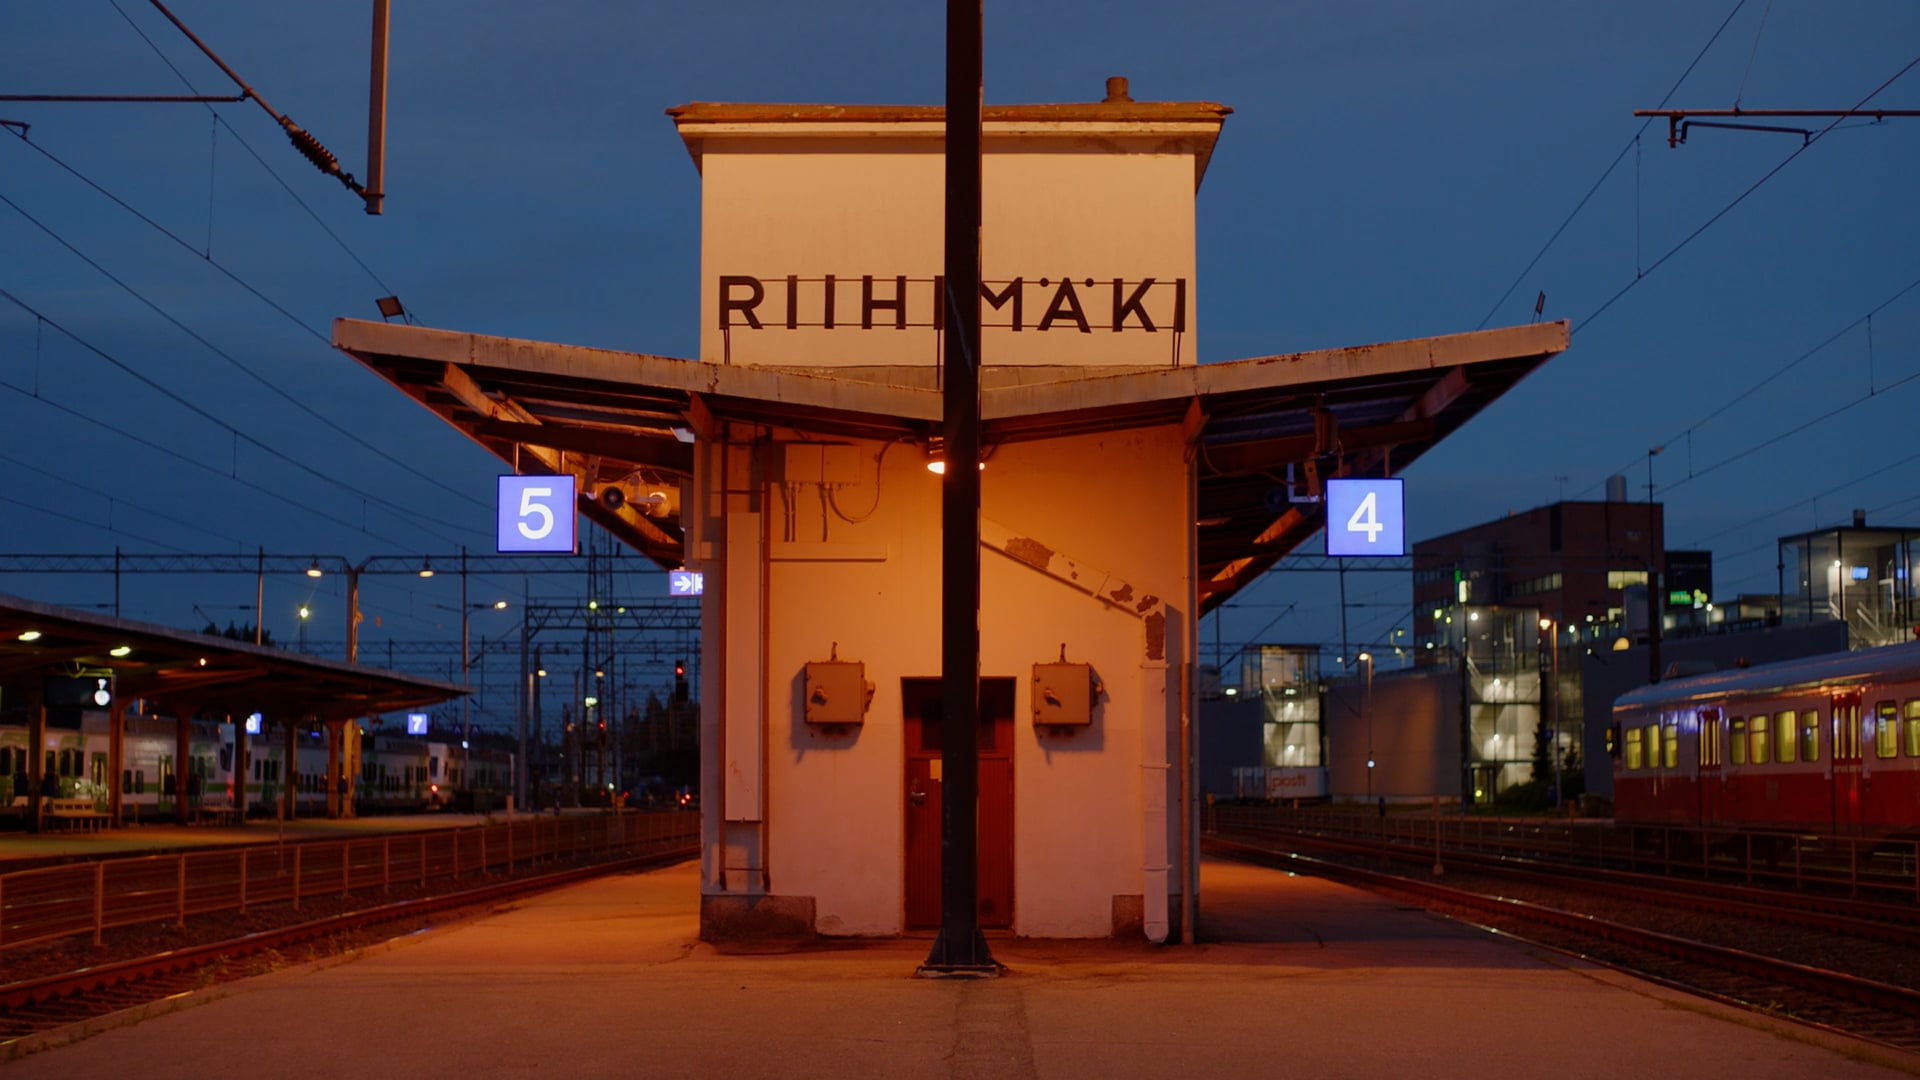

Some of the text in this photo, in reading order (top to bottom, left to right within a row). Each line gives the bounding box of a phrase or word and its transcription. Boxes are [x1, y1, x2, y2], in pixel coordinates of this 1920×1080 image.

[719, 275, 1186, 333] RIIHIMÄKI
[517, 487, 554, 540] 5
[1347, 491, 1384, 543] 4
[411, 715, 422, 732] 7
